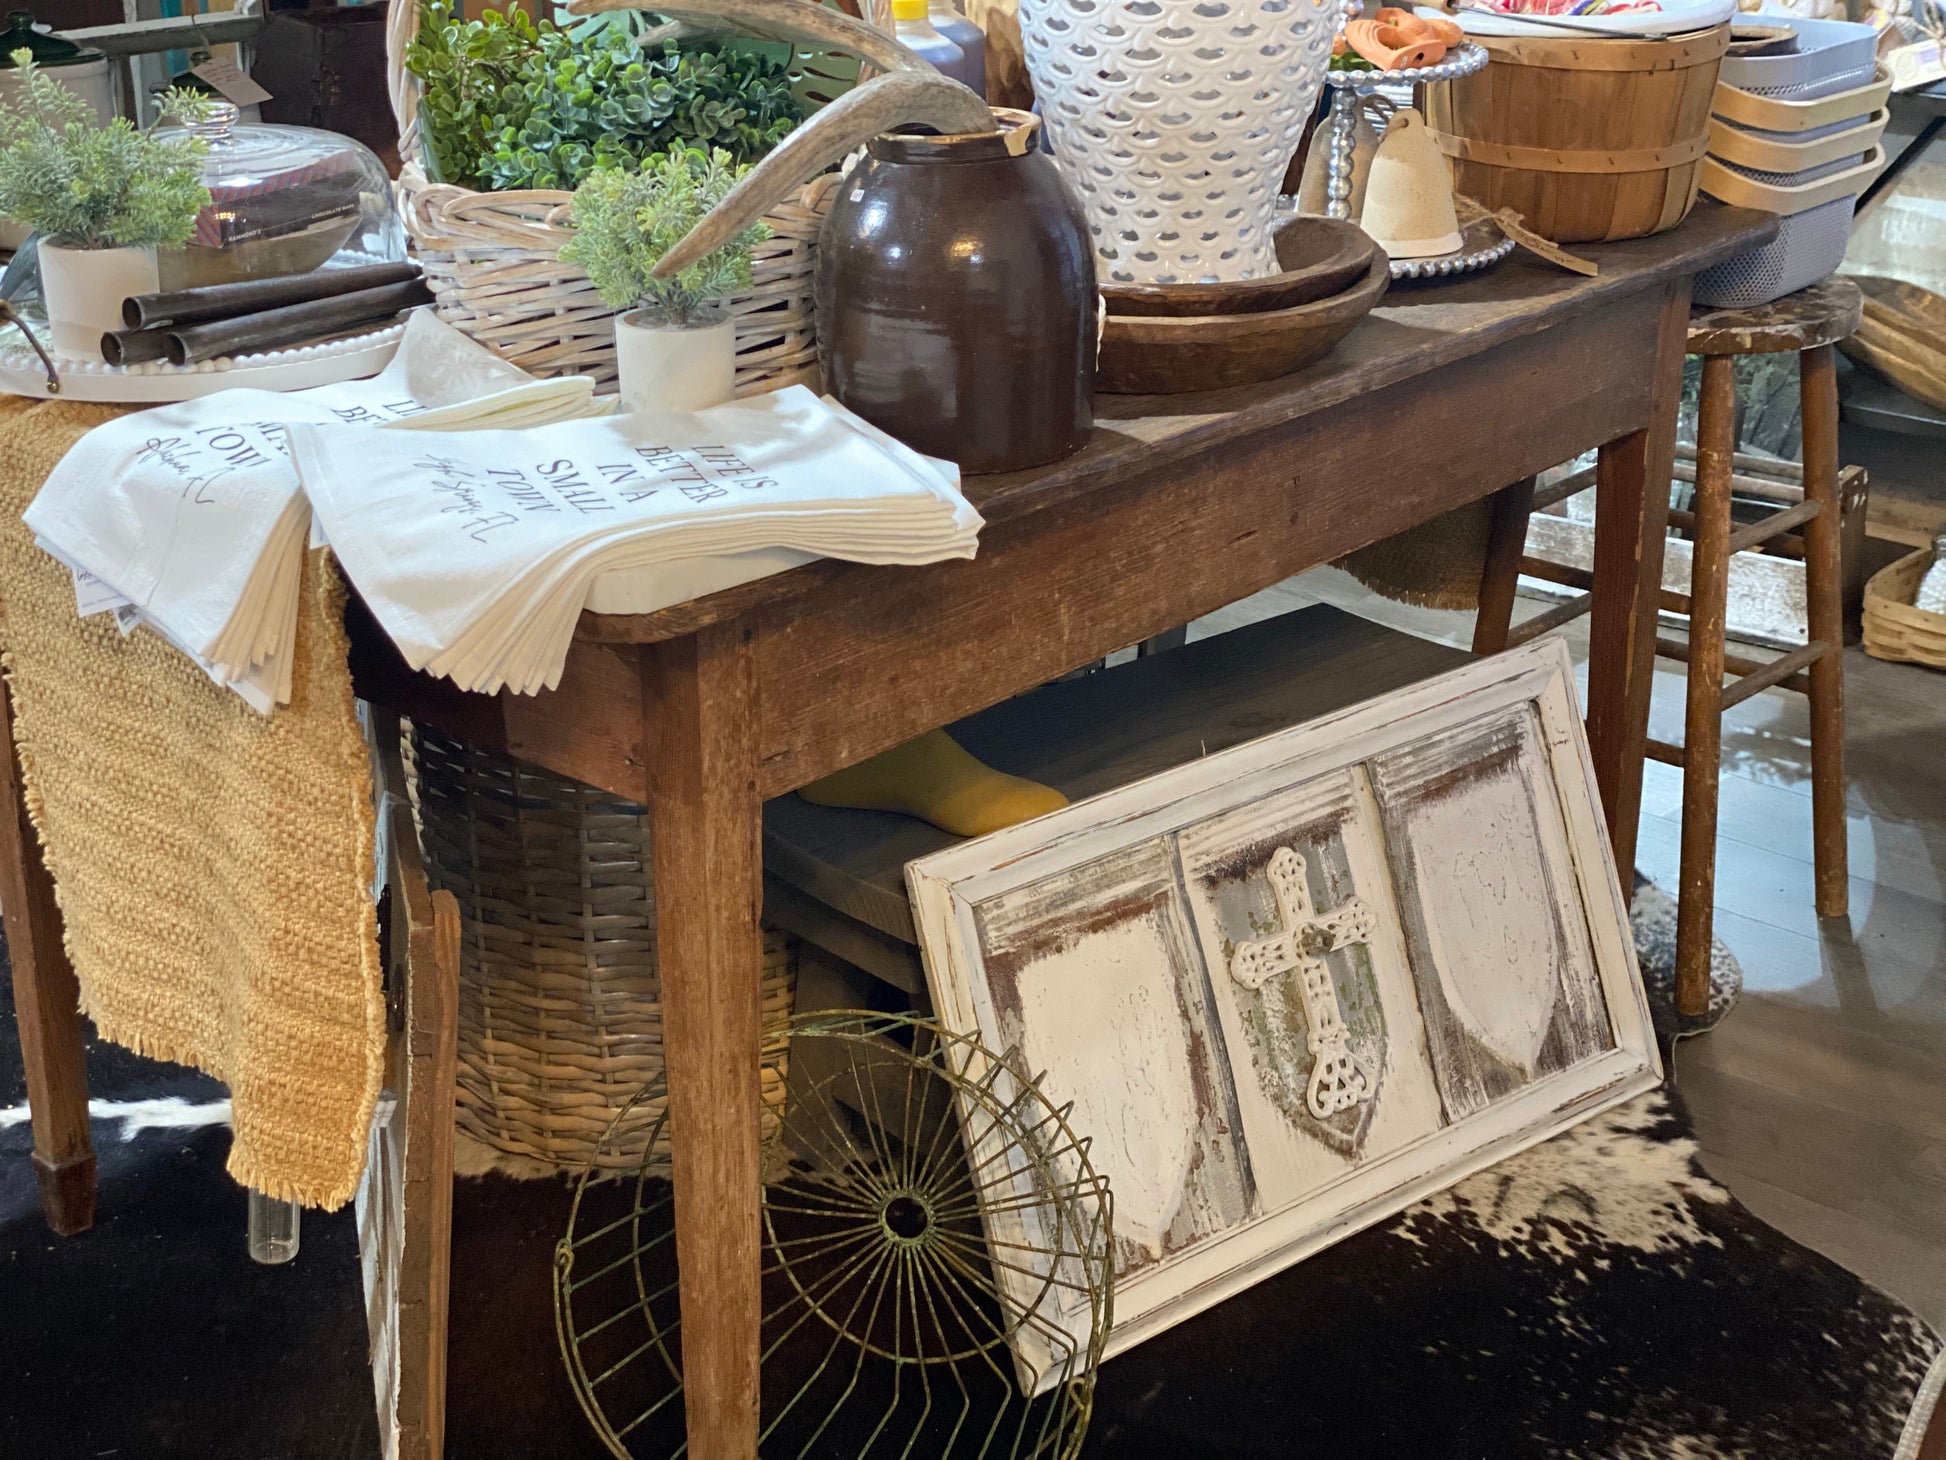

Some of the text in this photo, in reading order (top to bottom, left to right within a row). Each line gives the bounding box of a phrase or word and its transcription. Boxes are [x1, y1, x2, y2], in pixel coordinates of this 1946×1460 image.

[536, 459, 616, 514] SMALL
[596, 463, 660, 504] IN A
[634, 445, 728, 504] BETTER
[690, 445, 778, 490] LIFE IS
[486, 468, 561, 512] TOWN
[462, 511, 519, 544] FL
